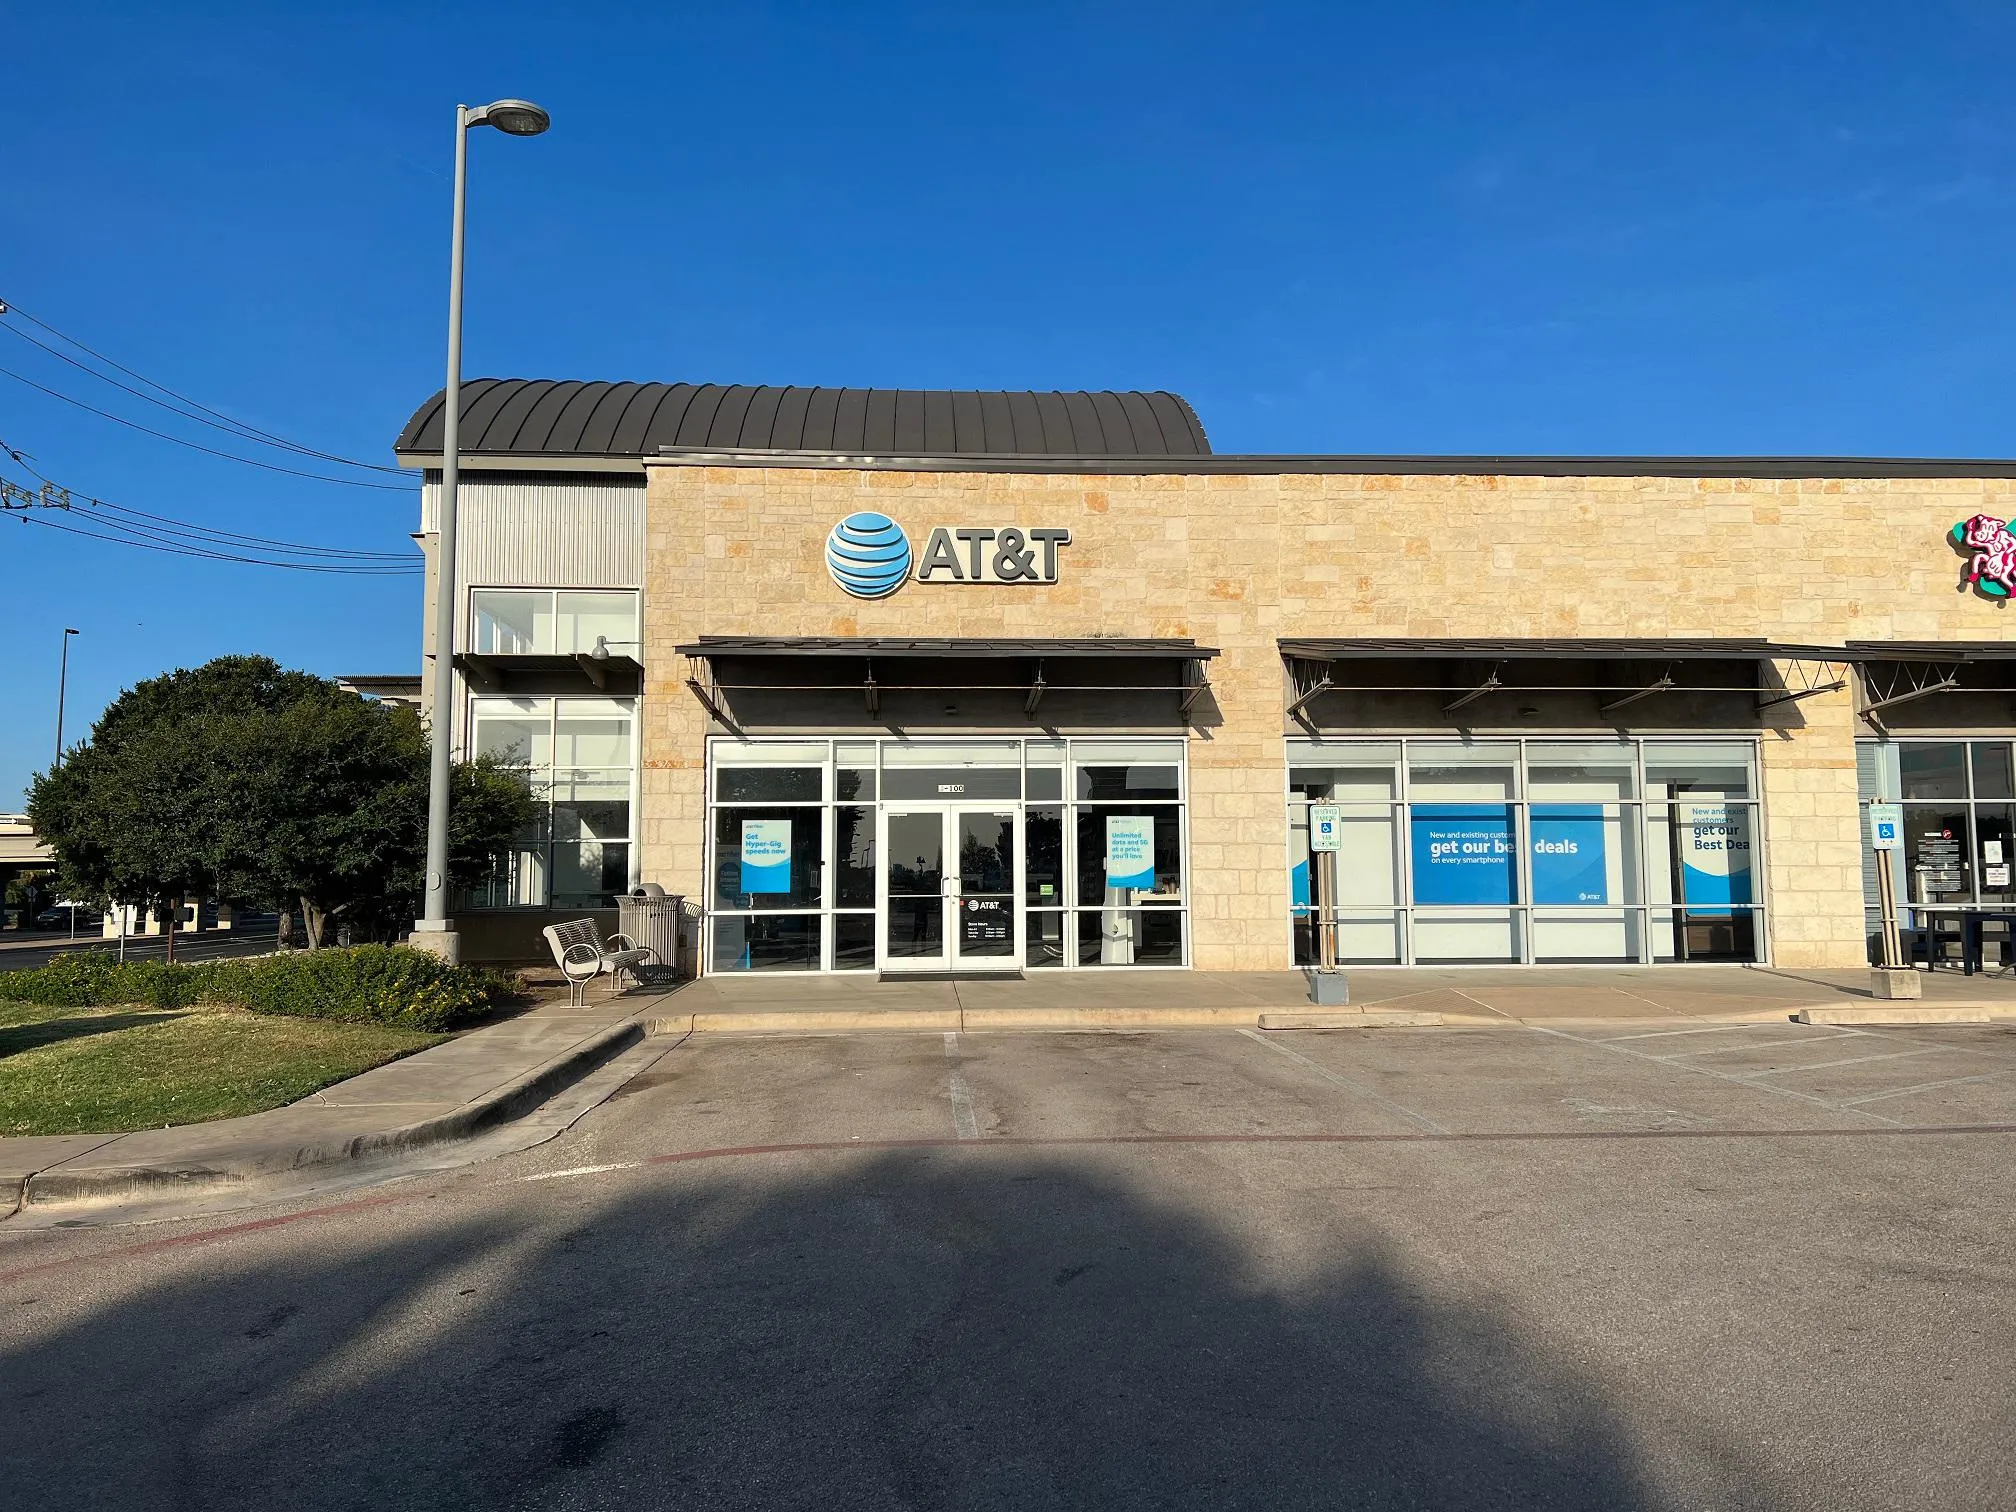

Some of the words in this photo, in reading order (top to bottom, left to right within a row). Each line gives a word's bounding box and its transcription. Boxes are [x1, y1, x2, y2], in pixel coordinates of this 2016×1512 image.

[919, 528, 1069, 580] AT&T
[1462, 832, 1488, 840] existing
[1694, 825, 1715, 838] get
[1718, 826, 1740, 836] our
[746, 840, 782, 848] Hyper-Gig
[1430, 840, 1459, 857] get
[1462, 842, 1491, 854] our
[1494, 839, 1517, 854] be
[1534, 839, 1578, 854] deals
[1694, 839, 1723, 850] Best
[1726, 839, 1750, 850] Dea
[1462, 856, 1504, 864] smartphone
[980, 902, 1000, 910] AT&T
